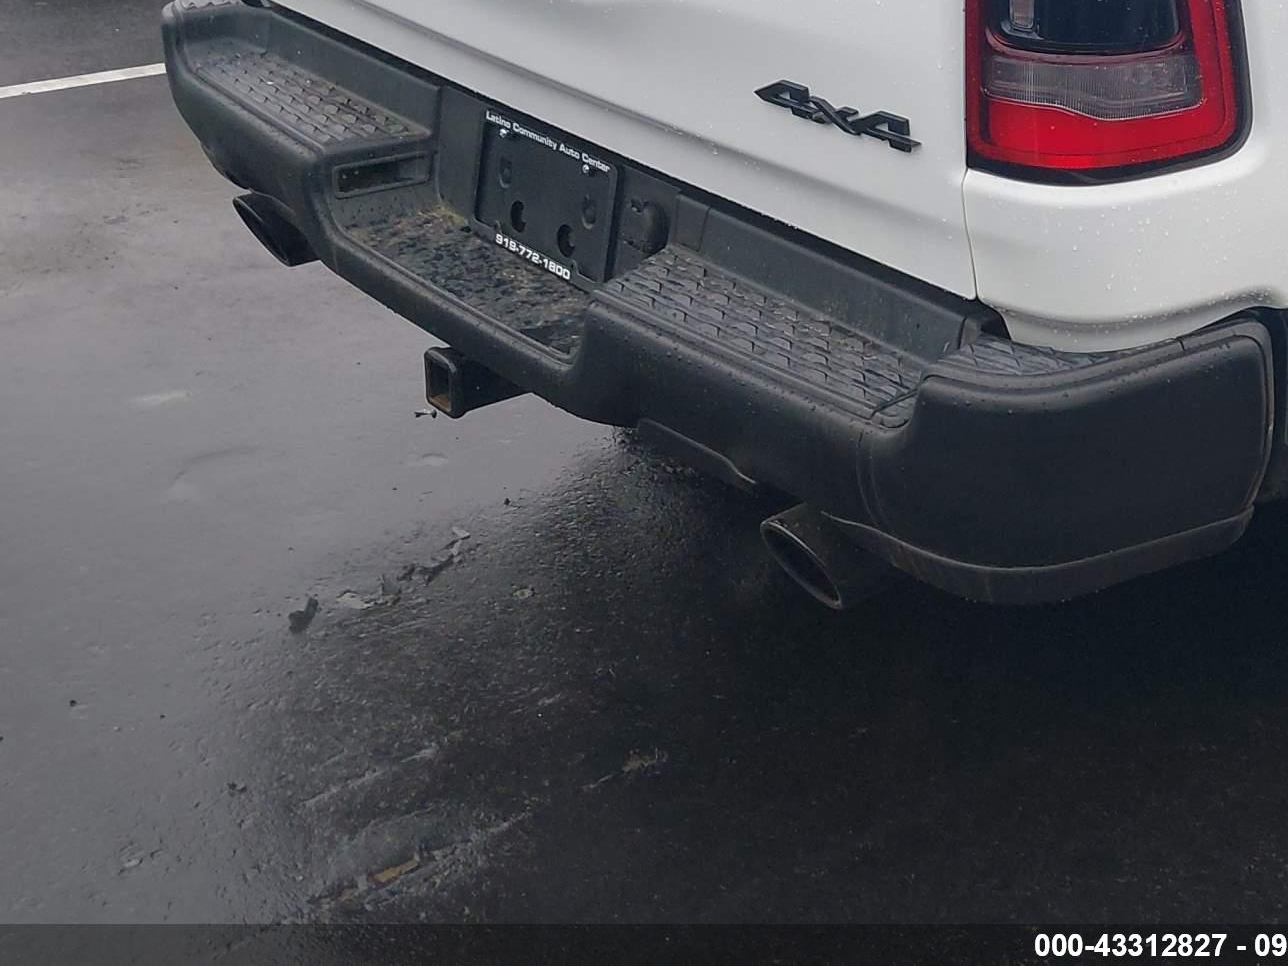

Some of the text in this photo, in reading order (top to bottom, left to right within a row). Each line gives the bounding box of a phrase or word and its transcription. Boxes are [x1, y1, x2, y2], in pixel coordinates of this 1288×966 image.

[486, 110, 610, 172] Latino Community Auto Center
[495, 233, 571, 281] 919-772-1800
